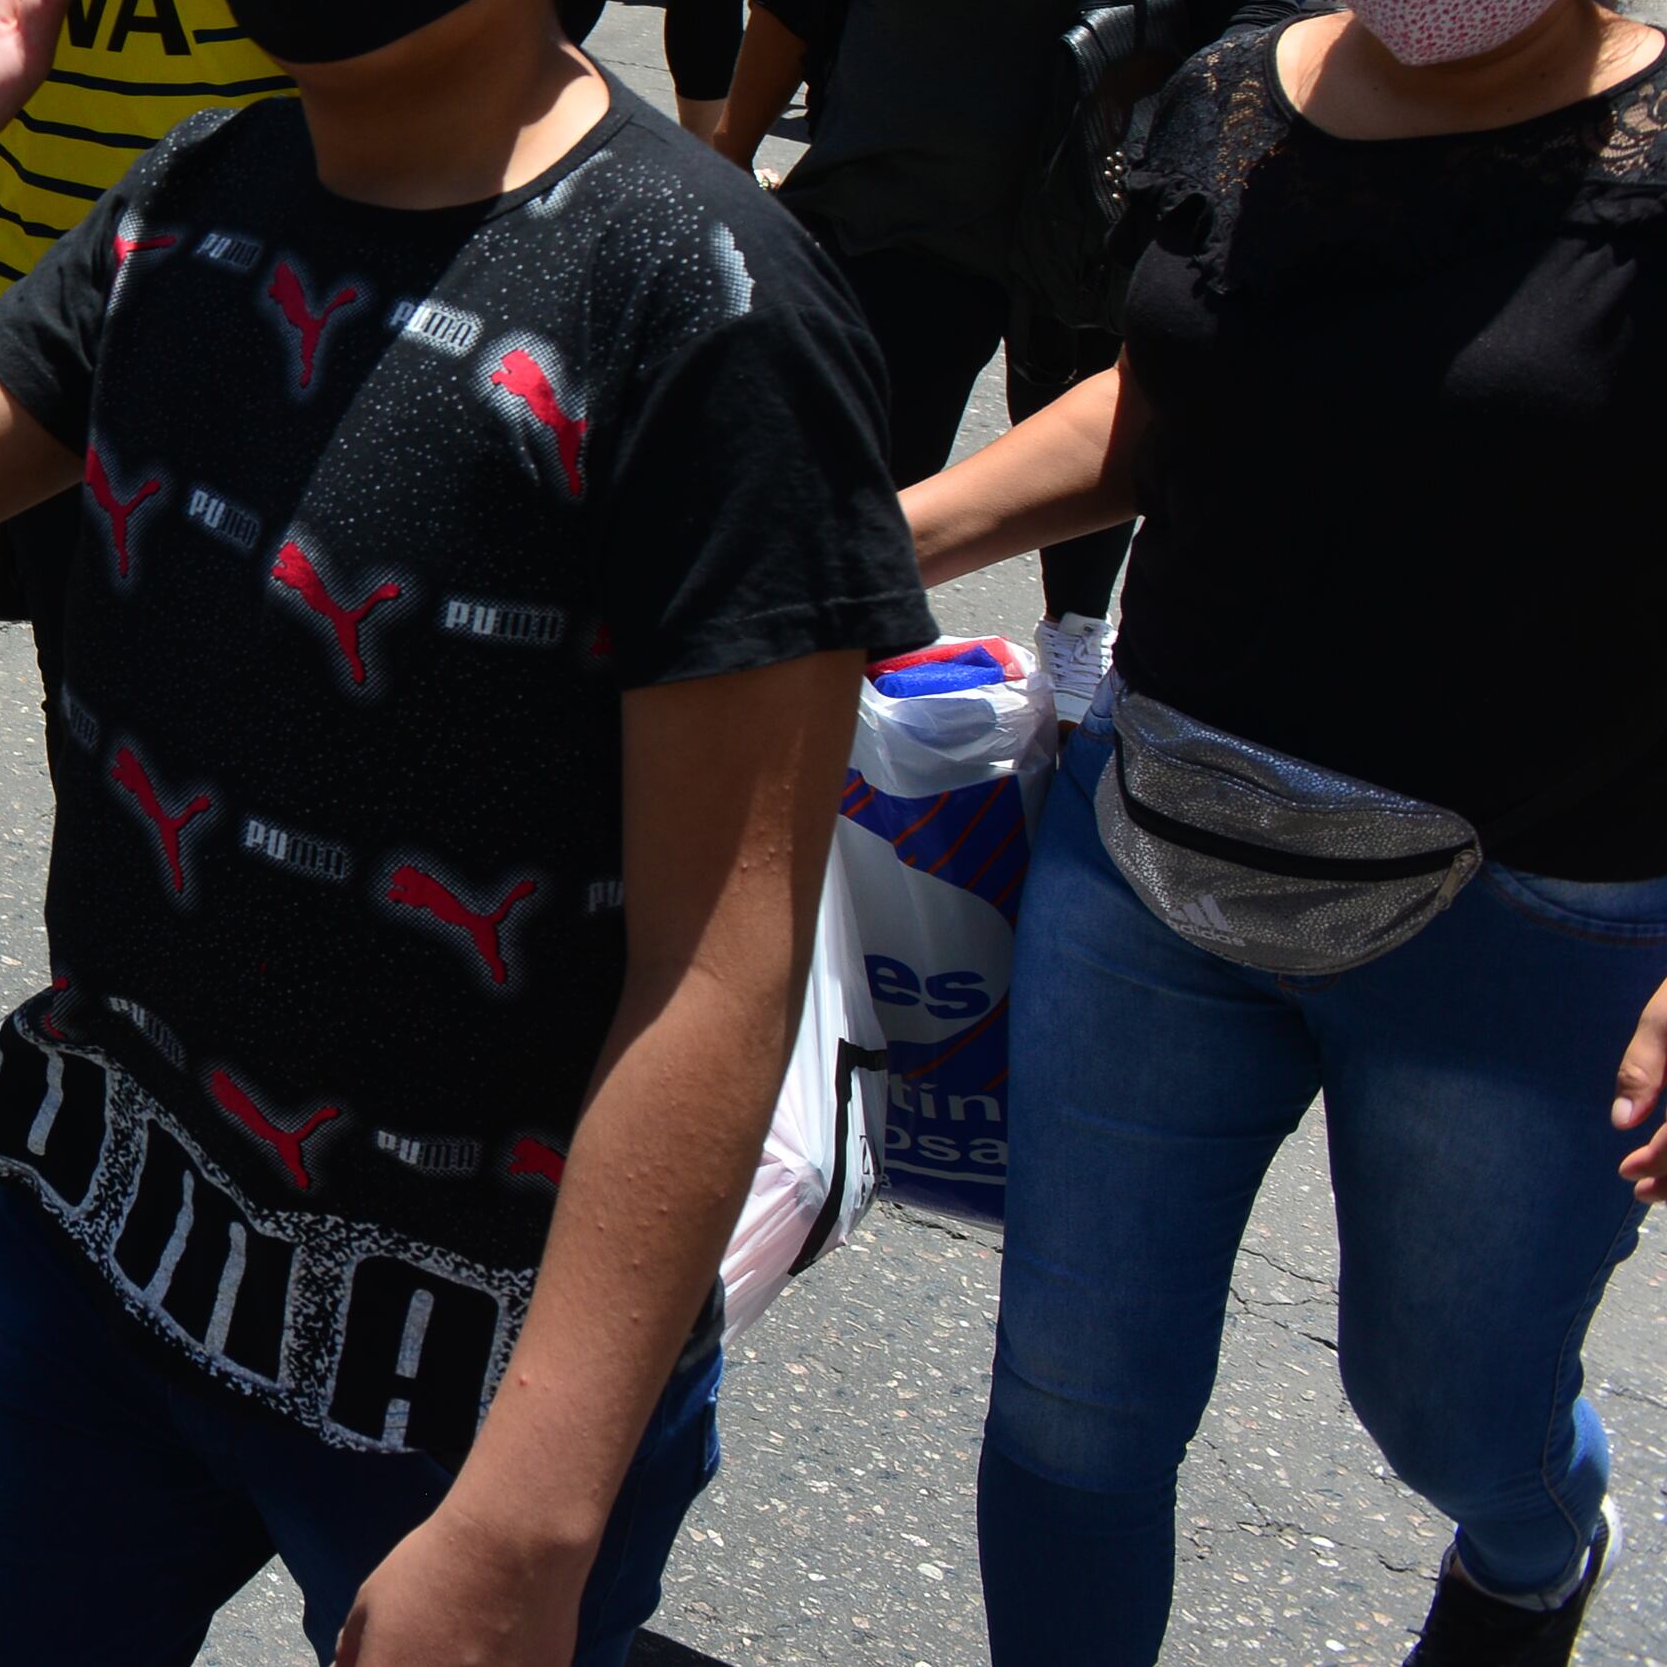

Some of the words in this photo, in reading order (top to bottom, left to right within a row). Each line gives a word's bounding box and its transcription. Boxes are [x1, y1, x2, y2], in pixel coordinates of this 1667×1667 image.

[196, 231, 260, 268] PUMA
[389, 299, 478, 349] PUMA
[187, 489, 260, 545] PUMA
[444, 601, 561, 646] PUMA
[244, 818, 348, 881] PUMA
[376, 1130, 479, 1172] PUMA
